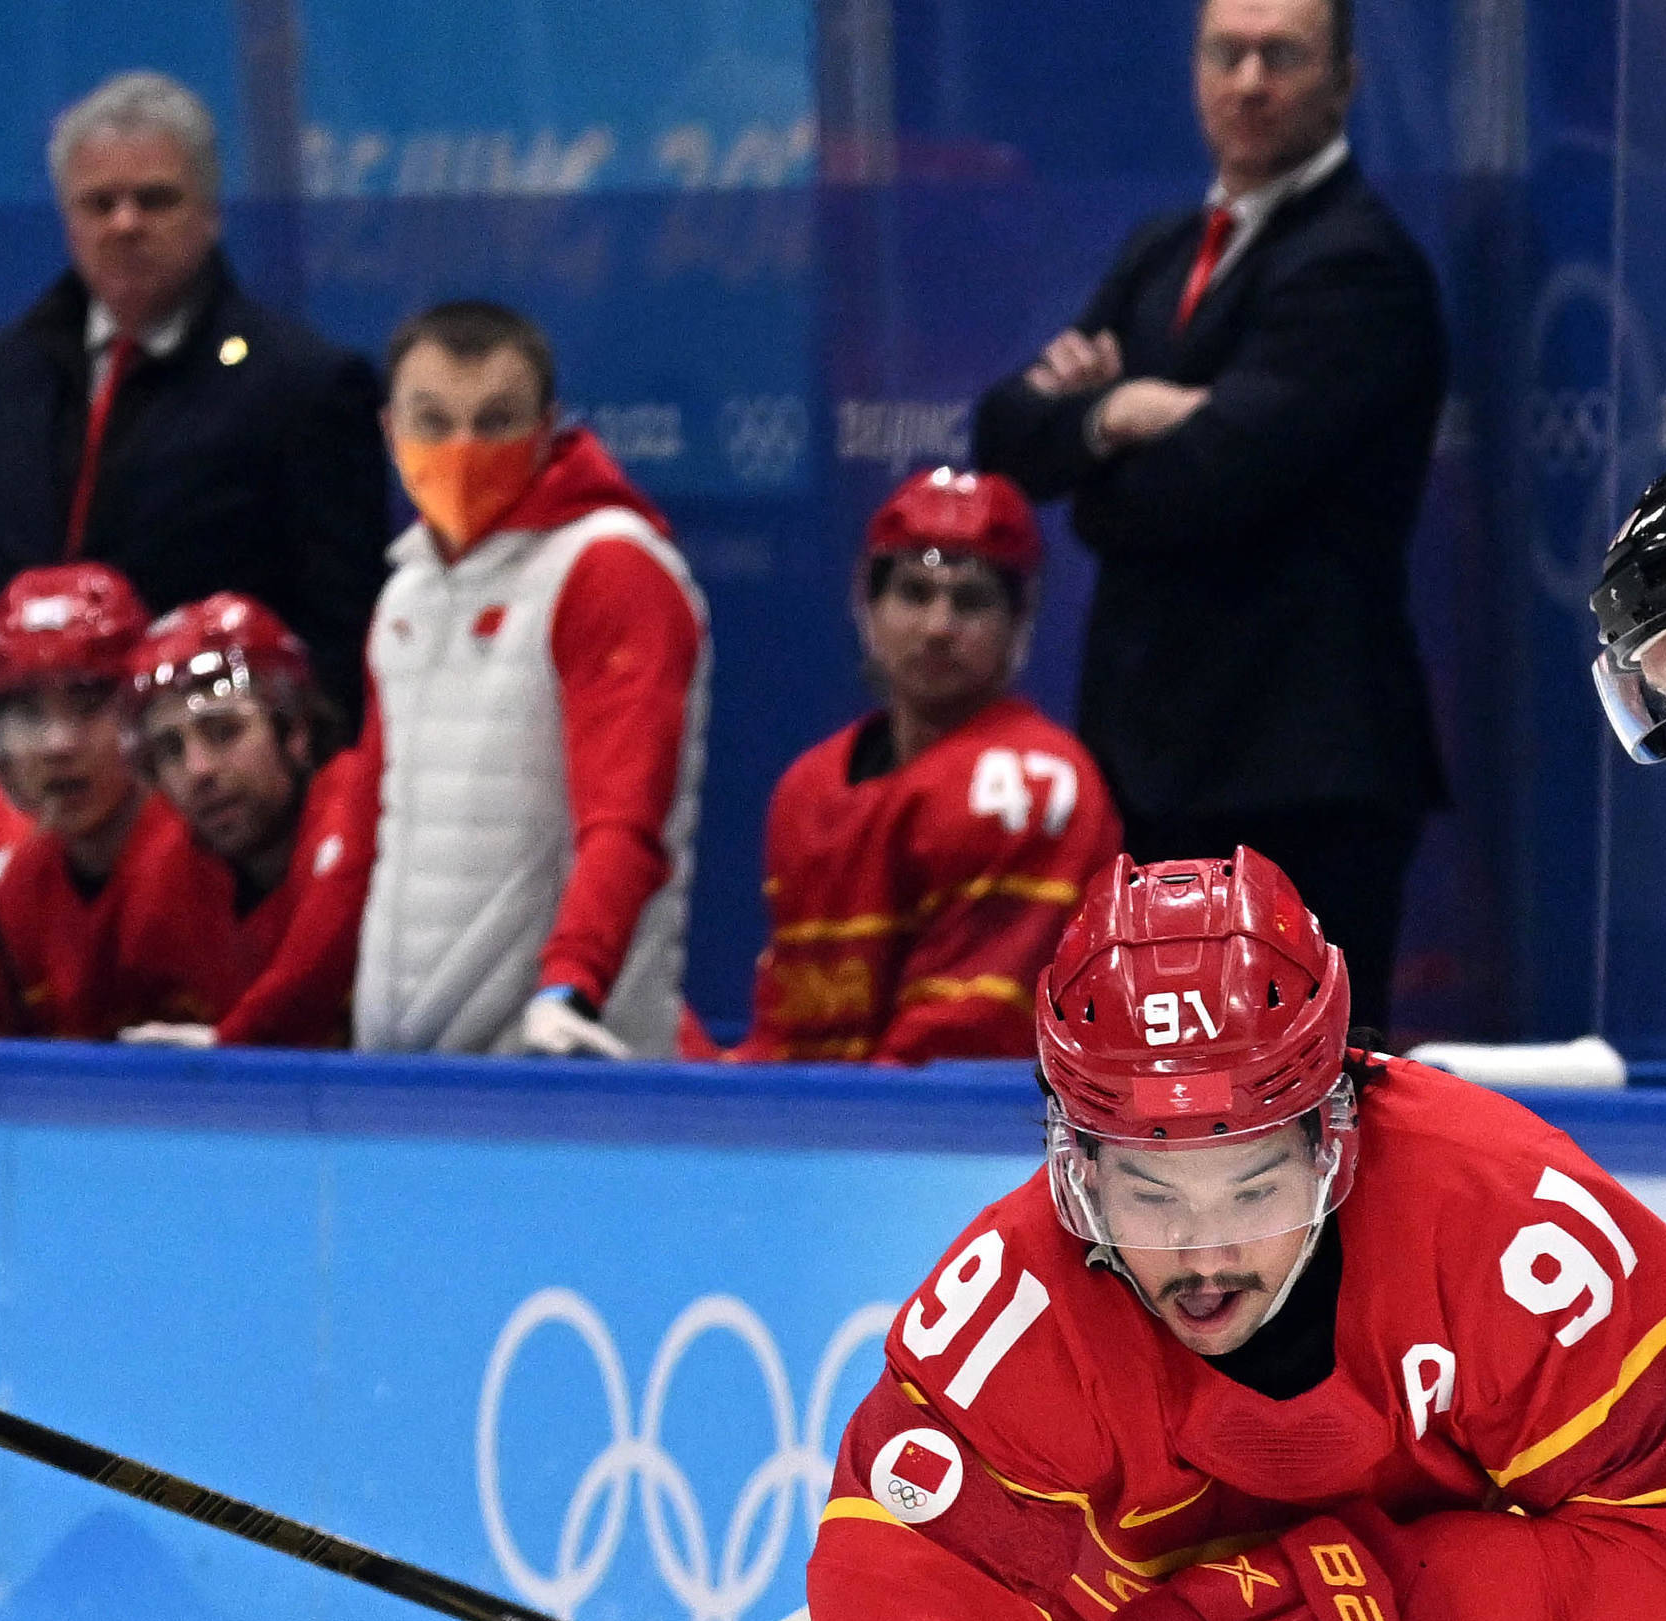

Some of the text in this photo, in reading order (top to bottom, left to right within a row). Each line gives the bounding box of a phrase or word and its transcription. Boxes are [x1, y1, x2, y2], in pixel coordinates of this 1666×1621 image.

[968, 748, 1078, 837] 47
[1143, 990, 1219, 1047] 91
[1499, 1165, 1639, 1348] 91
[902, 1228, 1051, 1411] 91
[1401, 1343, 1456, 1440] A
